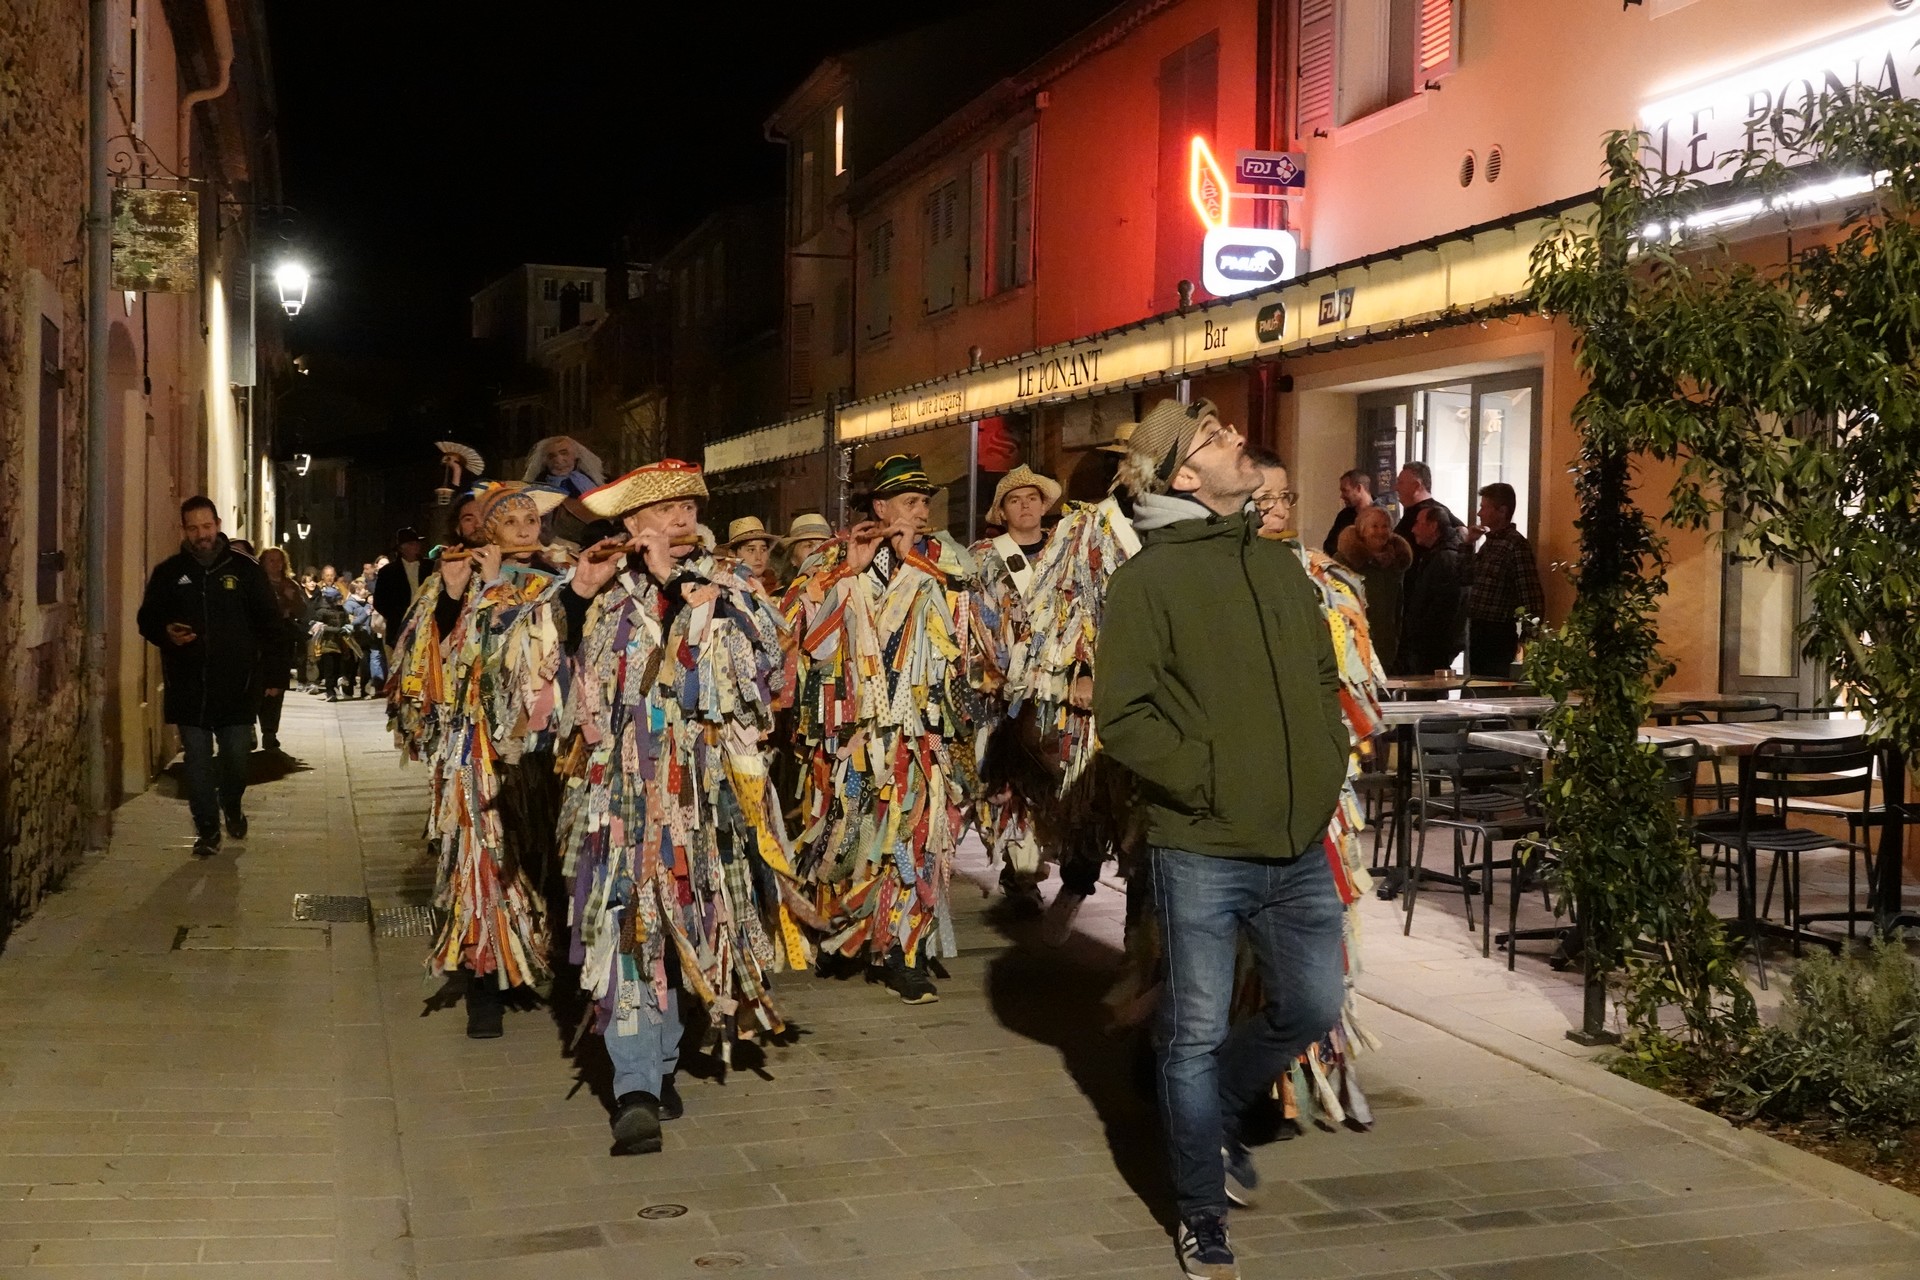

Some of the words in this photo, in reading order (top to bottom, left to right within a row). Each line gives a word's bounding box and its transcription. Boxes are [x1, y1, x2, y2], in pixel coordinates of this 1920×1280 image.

[1658, 106, 1715, 178] LE
[1246, 161, 1272, 174] FDJ
[1200, 167, 1220, 218] TABAC
[1203, 319, 1228, 350] Bar
[1259, 319, 1277, 333] PMU
[1017, 366, 1034, 397] LE
[1038, 348, 1102, 393] PONANT
[890, 402, 907, 422] Tabac
[917, 396, 932, 417] Cave
